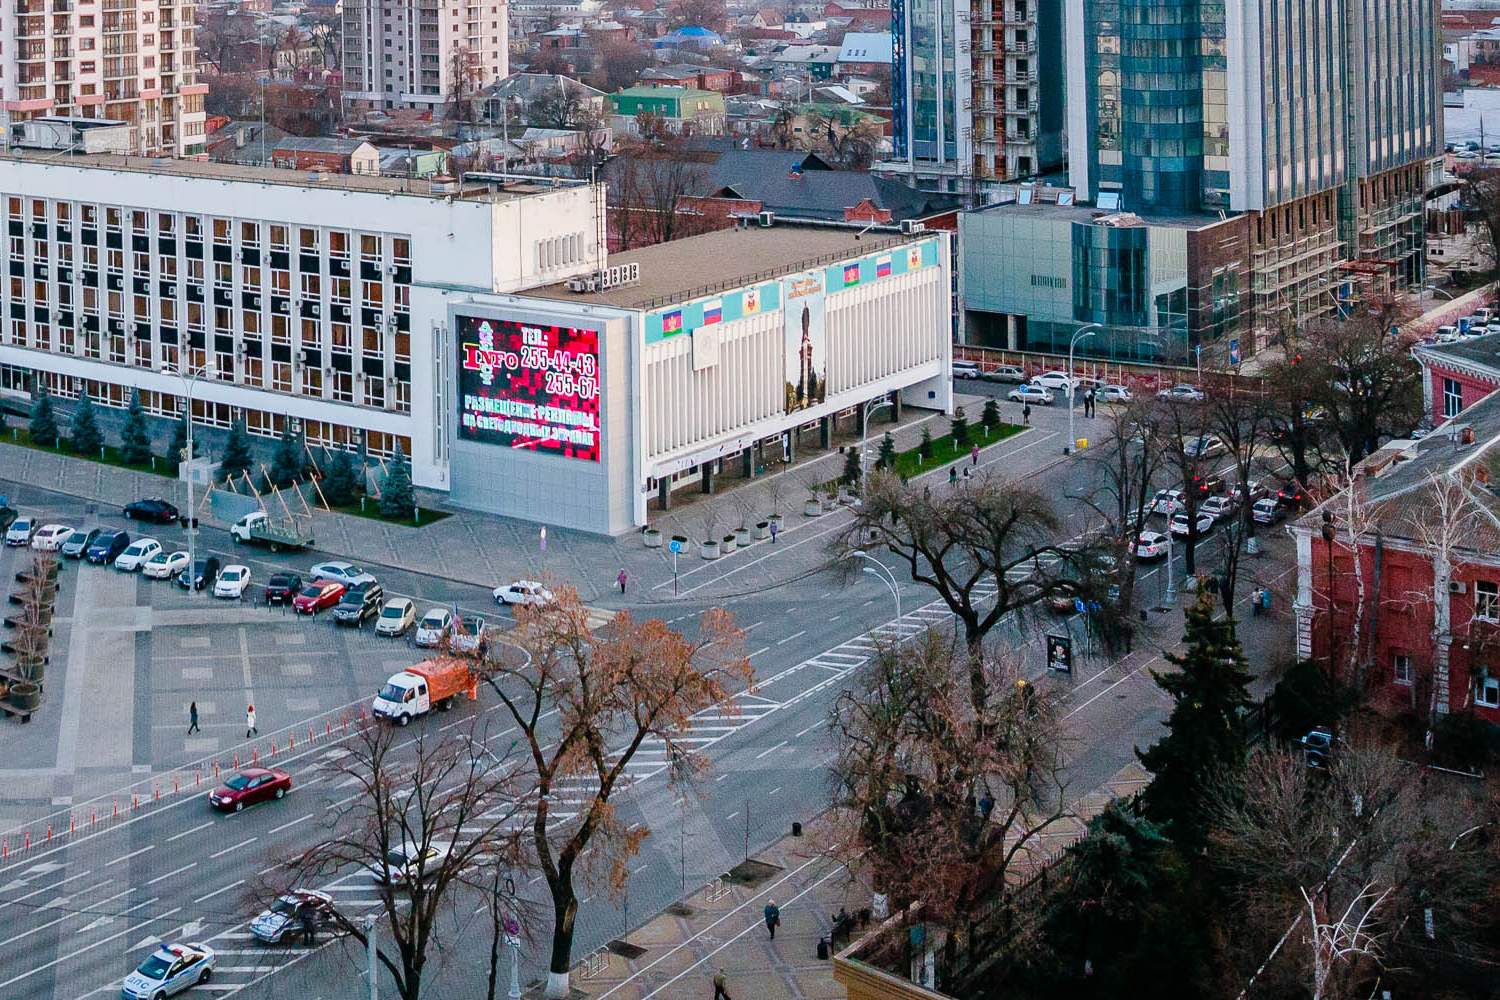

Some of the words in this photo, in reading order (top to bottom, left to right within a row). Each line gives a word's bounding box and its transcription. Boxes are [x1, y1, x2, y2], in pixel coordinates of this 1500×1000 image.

[521, 346, 594, 376] 255-44-43
[463, 413, 476, 427] НА
[464, 394, 537, 419] РАЗМЕЩЕНИЕ
[538, 405, 594, 428] РЕКЛАМЫ
[127, 976, 150, 990] ДПС
